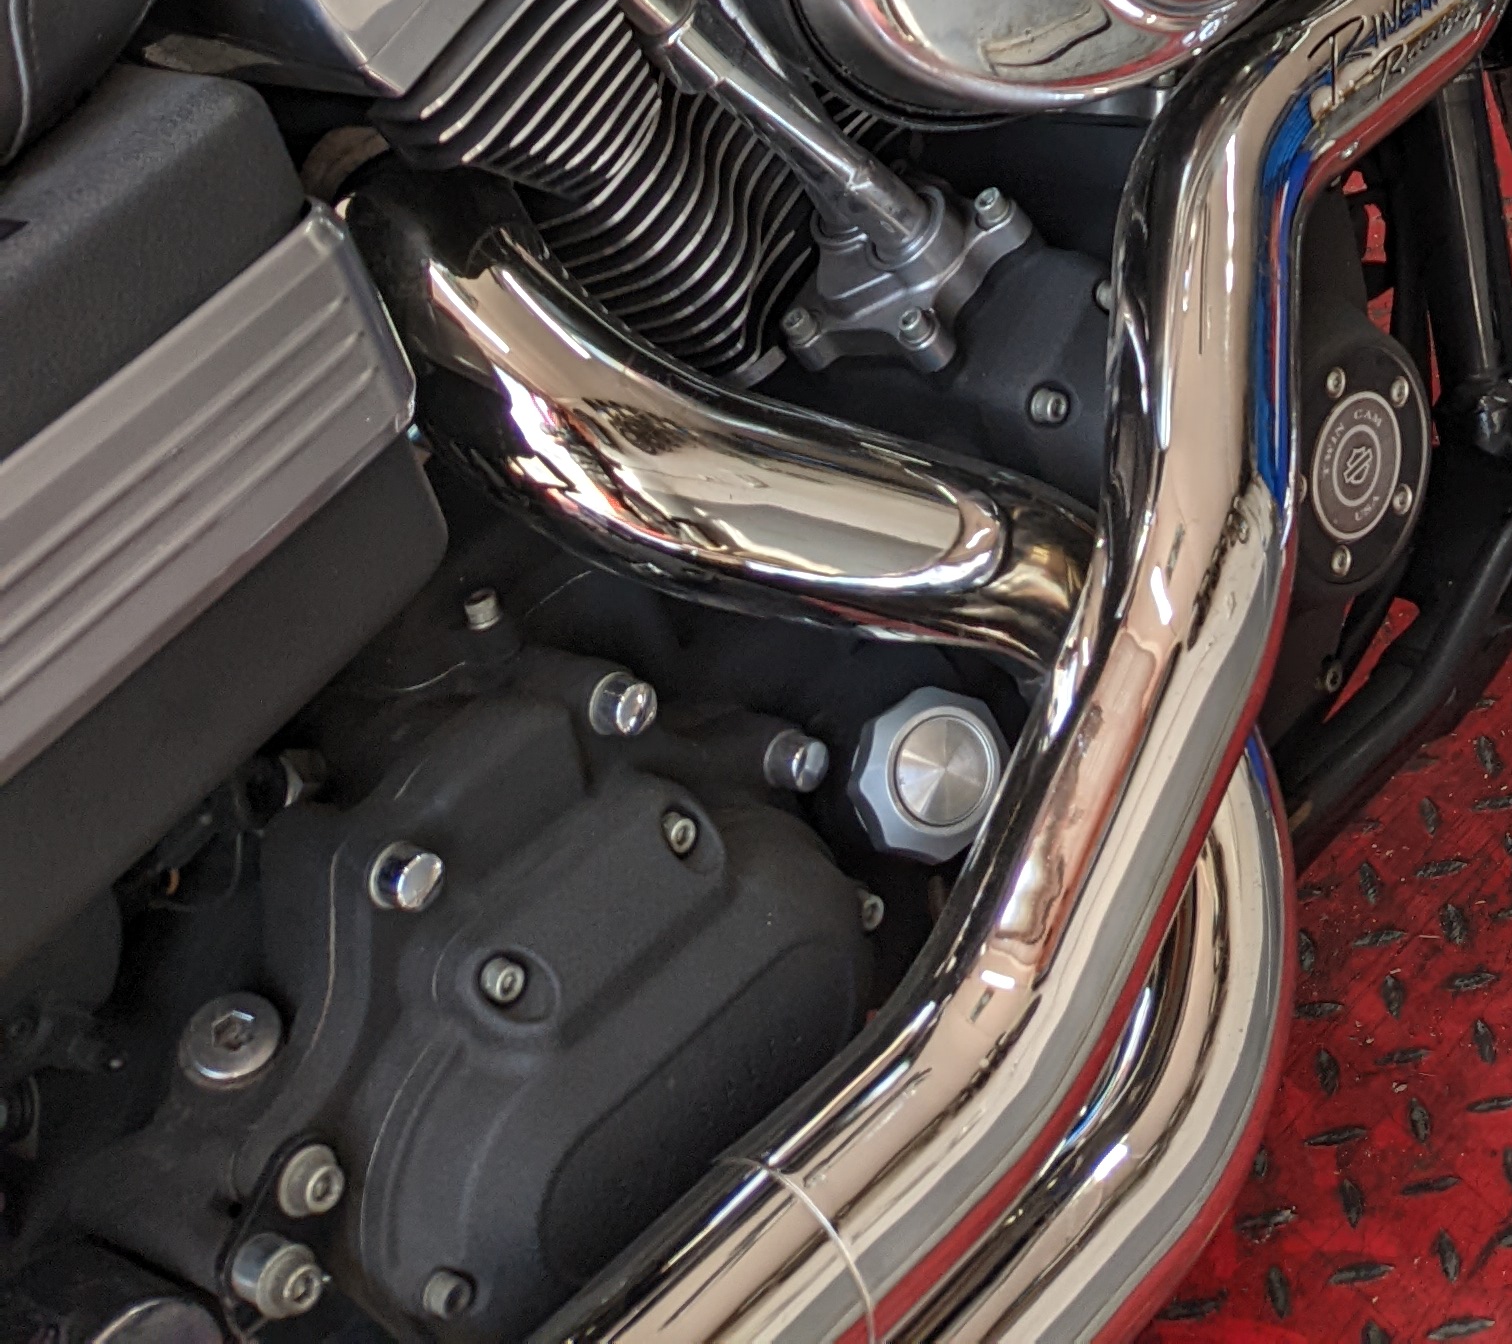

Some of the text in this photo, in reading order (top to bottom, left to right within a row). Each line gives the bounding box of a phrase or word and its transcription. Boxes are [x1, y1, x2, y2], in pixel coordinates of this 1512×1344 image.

[1322, 408, 1382, 476] TWIN CAM
[1354, 495, 1381, 522] USA
